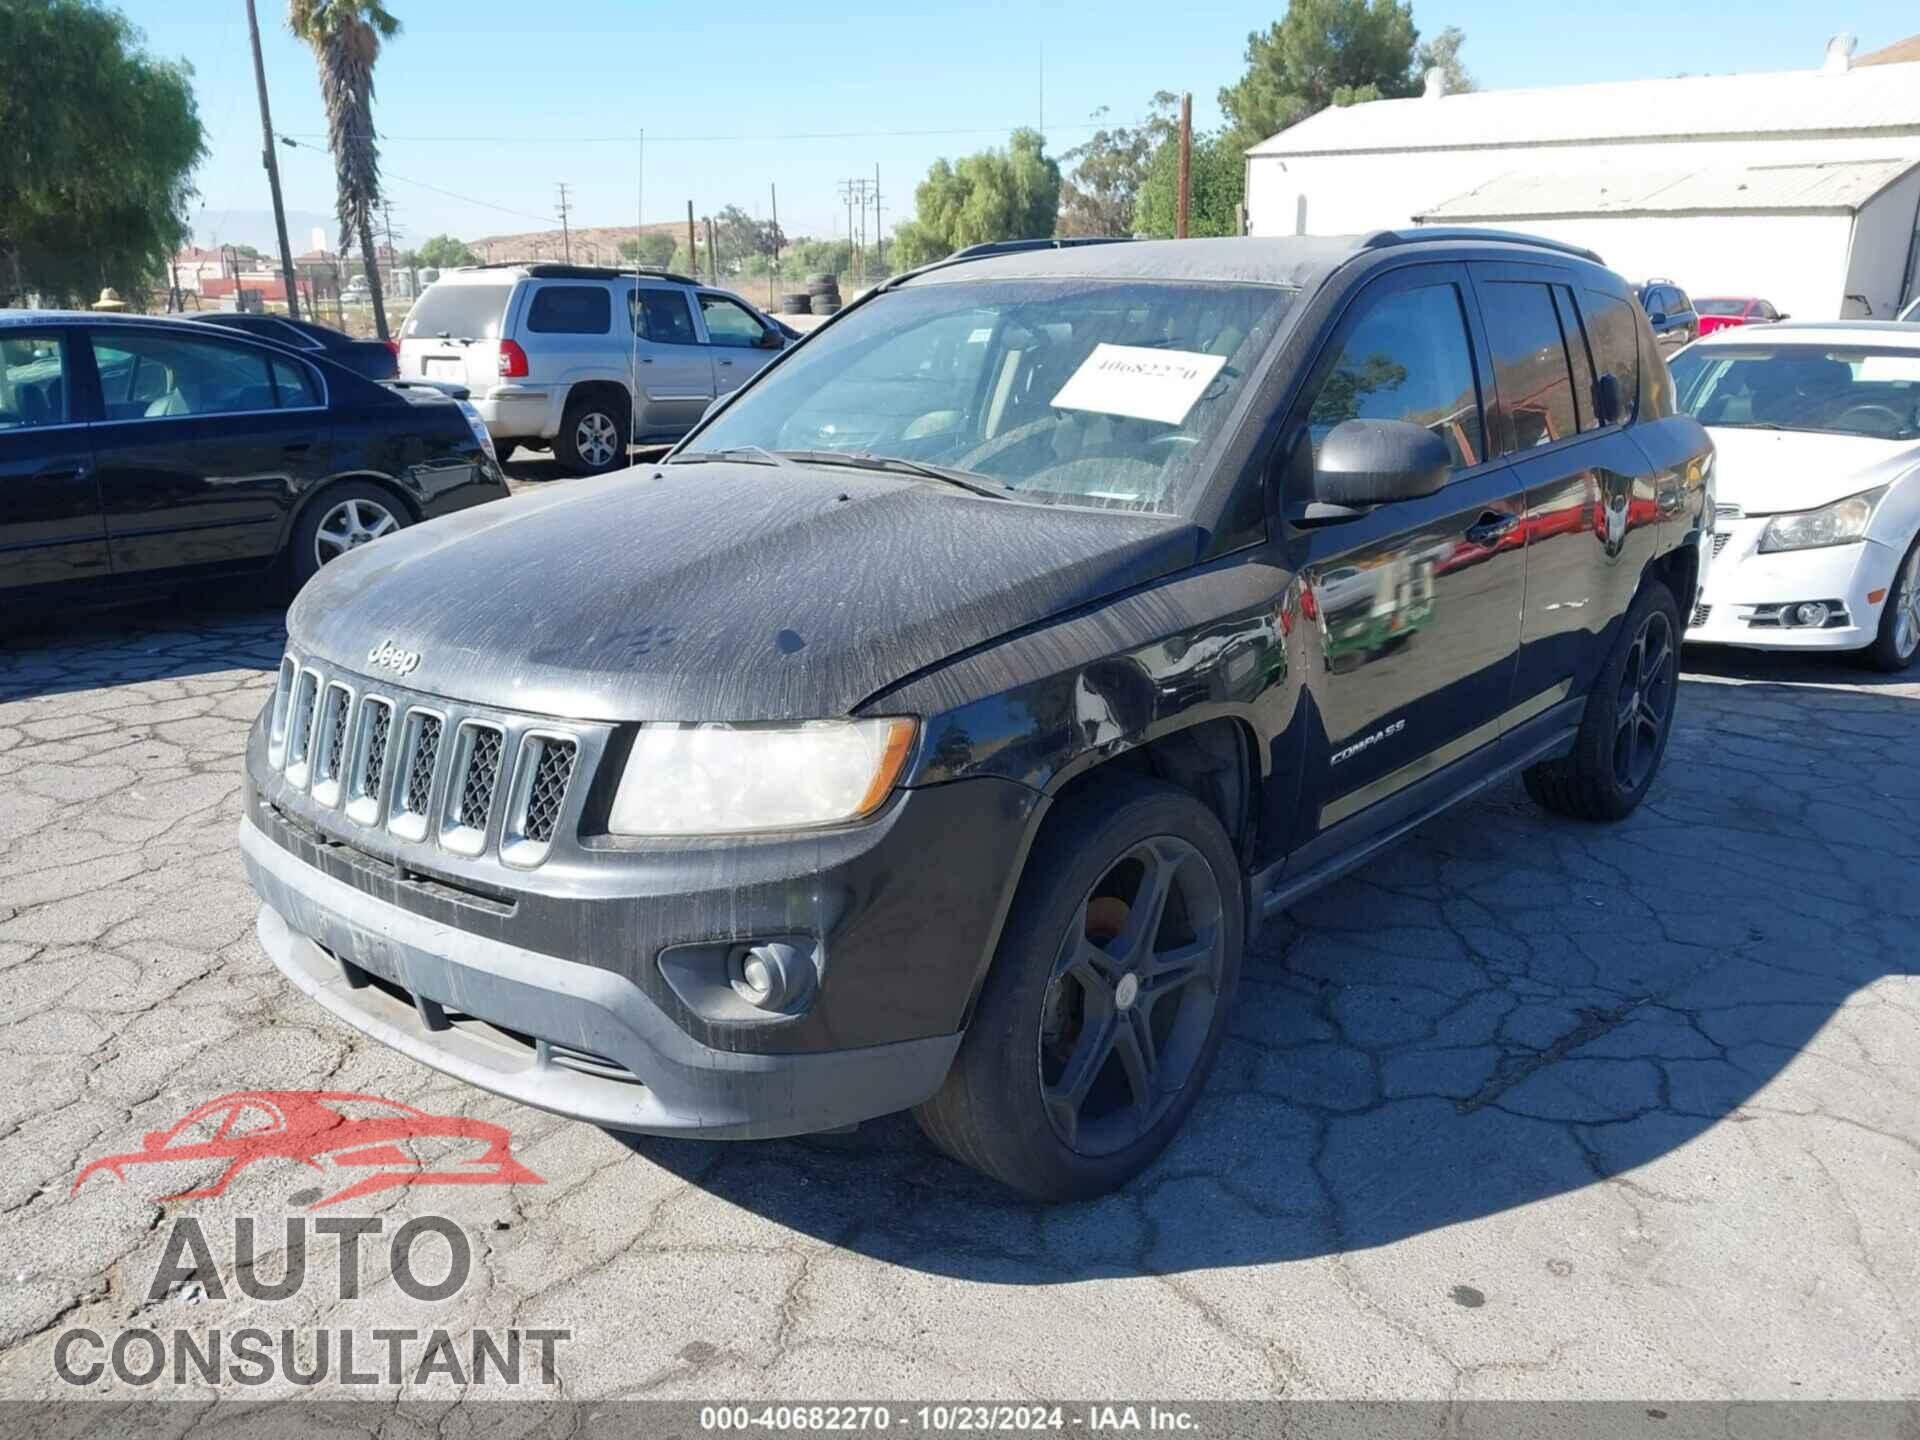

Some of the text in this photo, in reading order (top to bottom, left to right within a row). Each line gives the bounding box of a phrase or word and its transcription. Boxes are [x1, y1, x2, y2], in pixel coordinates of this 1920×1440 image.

[1099, 359, 1199, 380] 40682270
[367, 639, 421, 677] Jeep
[1330, 719, 1406, 767] COMPASS
